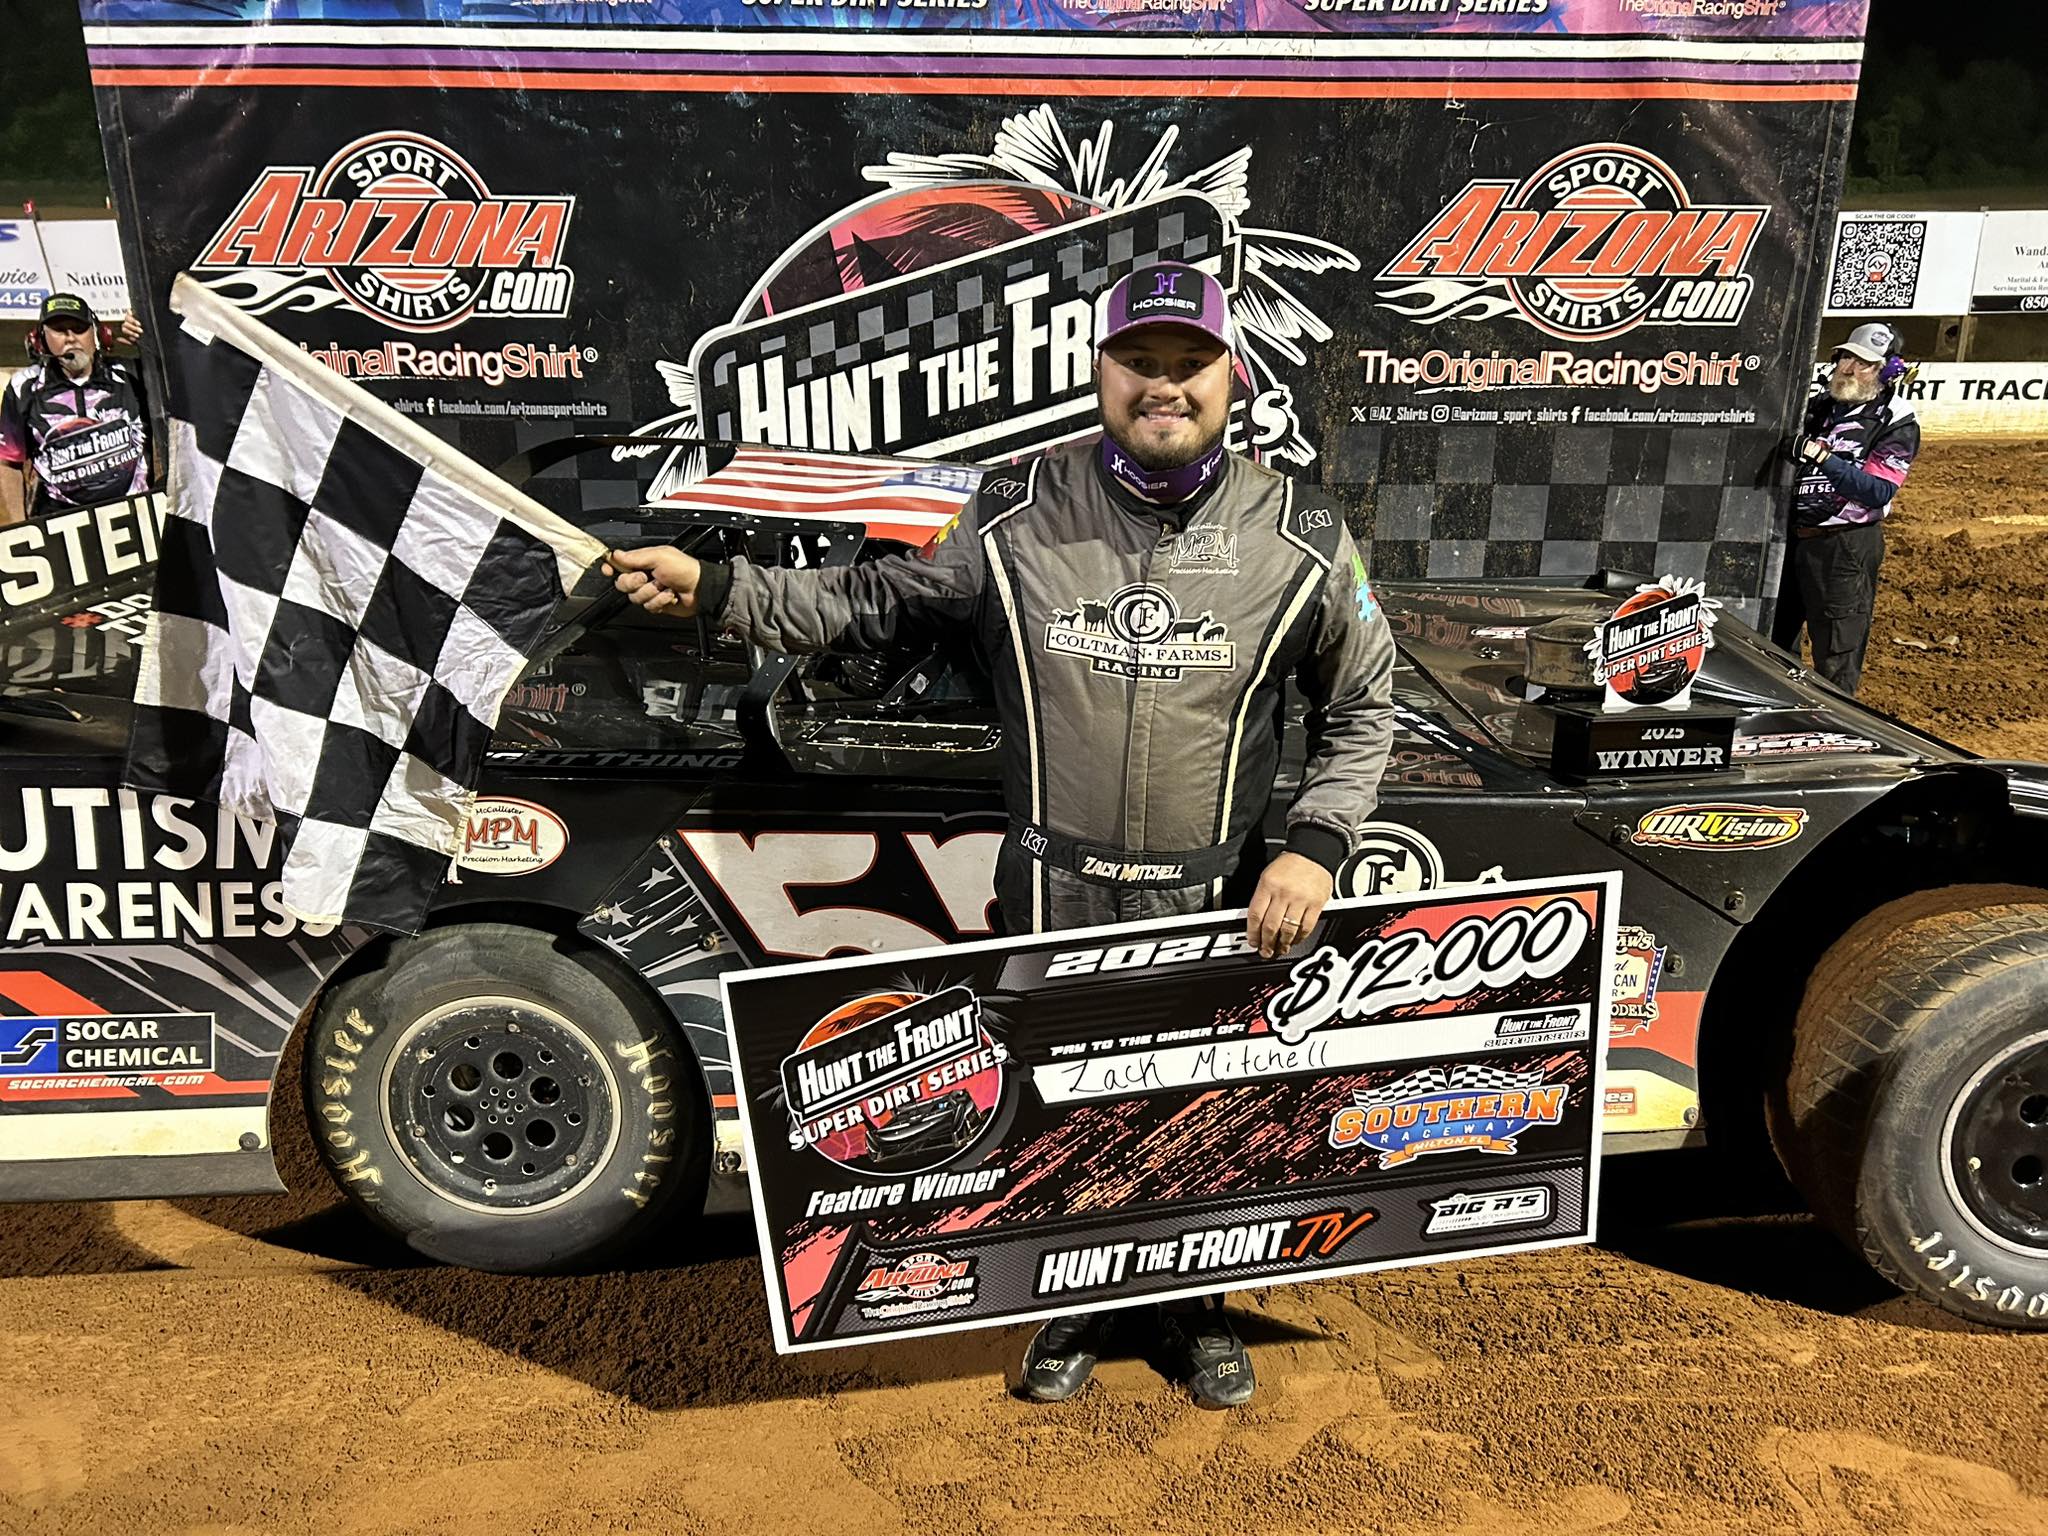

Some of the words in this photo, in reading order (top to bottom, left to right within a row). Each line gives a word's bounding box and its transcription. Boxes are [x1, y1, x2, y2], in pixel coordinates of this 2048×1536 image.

[347, 147, 459, 190] SPORT
[1548, 158, 1663, 200] SPORT
[198, 172, 570, 269] ARIZONA
[1386, 180, 1763, 278] ARIZONA
[354, 272, 473, 319] SHIRTS
[1132, 297, 1197, 312] HOOSIER
[1529, 283, 1647, 328] SHIRTS
[737, 352, 910, 452] HUNT
[918, 341, 999, 418] THE
[1959, 379, 2048, 401] TRAC
[438, 398, 608, 418] facebook.com/arizonasportshirts
[1584, 406, 1756, 425] facebook.com/arizonasportshirts
[90, 426, 131, 452] FRONT
[78, 460, 105, 479] DIRT
[1123, 466, 1169, 489] HOOSIER
[1608, 625, 1642, 655] HUNT
[1642, 621, 1660, 638] THE
[1659, 603, 1700, 636] FRONT
[1096, 659, 1178, 678] RACING
[1597, 659, 1637, 682] SUPER
[1638, 649, 1669, 669] DIRT
[1668, 630, 1712, 655] SERIES
[594, 751, 745, 768] THING
[1596, 746, 1724, 770] WINNER
[464, 816, 541, 856] MPM
[1081, 855, 1119, 880] ZACK
[1119, 863, 1184, 882] MITCHELL
[1044, 931, 1259, 980] 2025
[1500, 1017, 1530, 1033] HUNT
[1542, 1013, 1578, 1029] FRONT
[1610, 1002, 1657, 1018] ODELS
[65, 1019, 160, 1042] SOCAR
[1050, 1044, 1087, 1057] PAY
[1091, 1038, 1114, 1051] TO
[1118, 1035, 1152, 1047] THE
[1156, 1026, 1212, 1042] ORDER
[65, 1045, 204, 1069] CHEMICAL
[797, 1050, 863, 1106] HUNT
[865, 1041, 898, 1073] THE
[894, 1003, 975, 1064] FRONT
[1190, 1040, 1329, 1081] Mitchell
[7, 1073, 206, 1091] SOCARCHEMICAL.COM
[788, 1104, 865, 1151] SUPER
[866, 1077, 923, 1118] DIRT
[927, 1042, 1010, 1092] SERIES
[1332, 1086, 1565, 1144] SOUTHERN
[805, 1183, 906, 1218] Feature
[911, 1167, 1006, 1203] Winner
[1437, 1200, 1487, 1218] BIG
[1038, 1242, 1134, 1294] HUNT
[1136, 1240, 1179, 1274] THE
